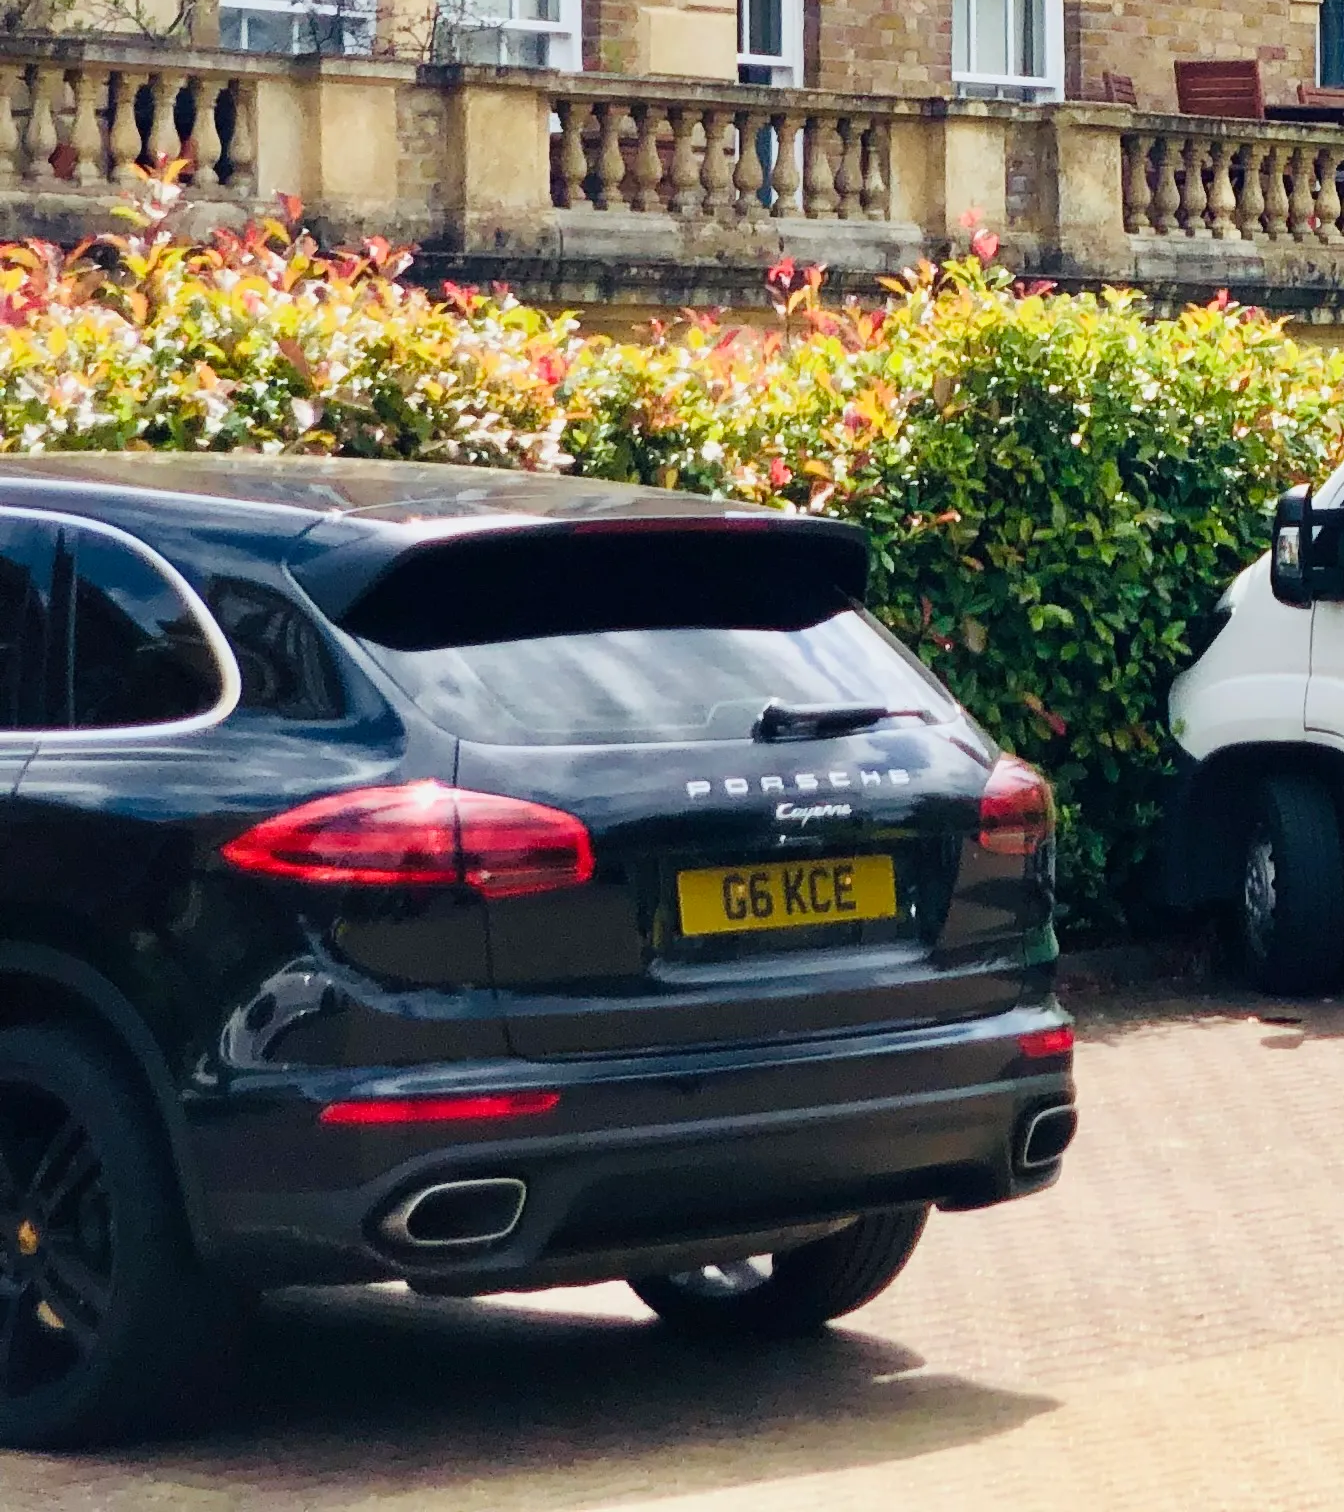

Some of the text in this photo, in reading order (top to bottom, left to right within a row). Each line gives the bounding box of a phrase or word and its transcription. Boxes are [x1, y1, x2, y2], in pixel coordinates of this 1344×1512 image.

[686, 768, 910, 799] PORSCHE
[775, 802, 852, 828] Cayenne
[723, 864, 856, 920] G6 KCE
